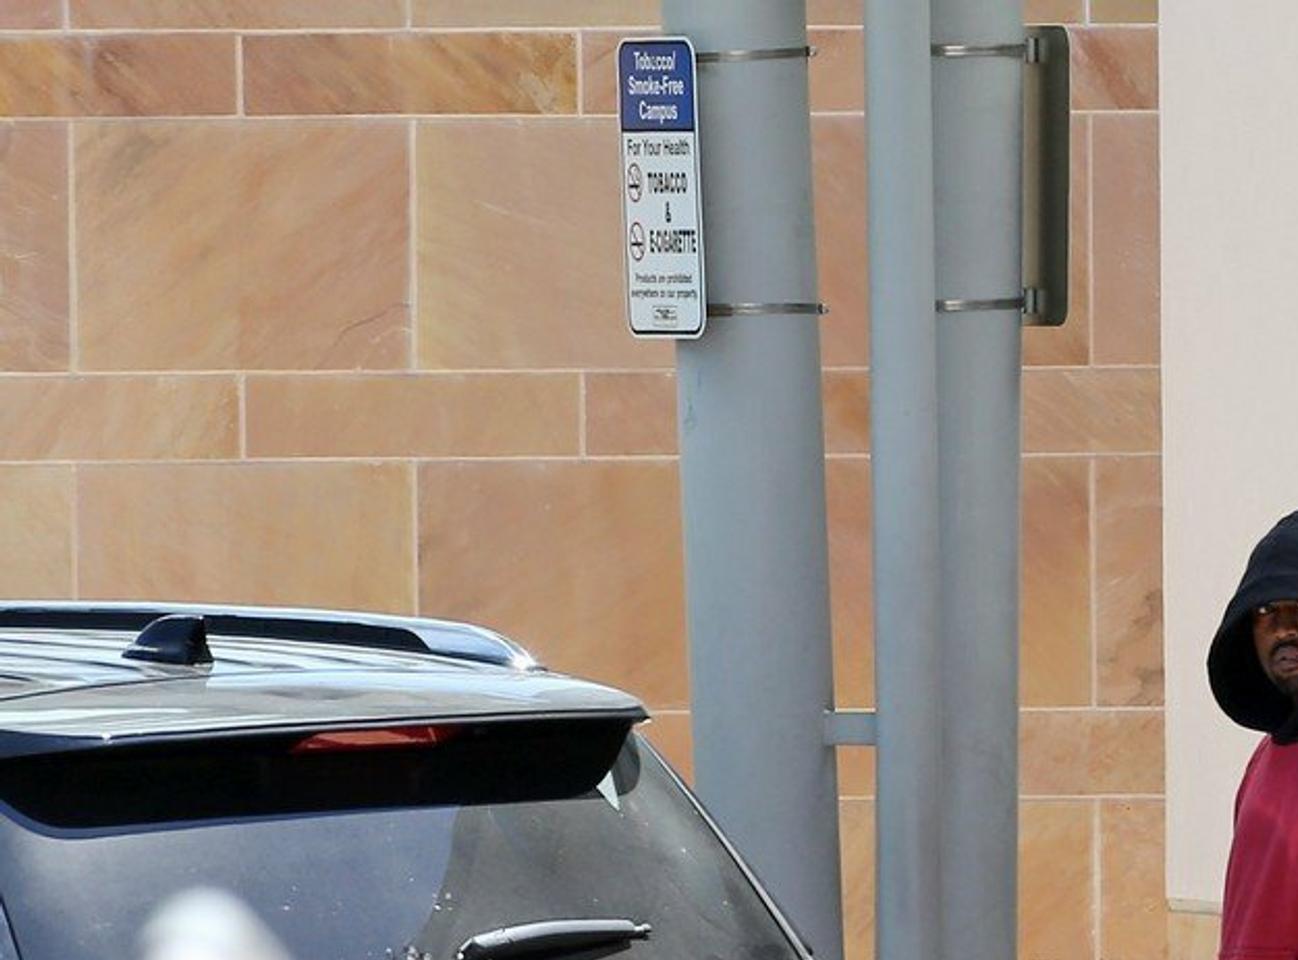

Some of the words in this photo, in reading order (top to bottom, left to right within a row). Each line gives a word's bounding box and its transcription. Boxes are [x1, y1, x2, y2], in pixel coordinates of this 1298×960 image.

[628, 75, 684, 95] Smoke-Free
[639, 100, 678, 125] Campus
[627, 139, 641, 155] For
[642, 139, 662, 156] Your
[663, 138, 690, 156] Health
[647, 172, 688, 194] TOBACCO
[665, 201, 672, 223] &
[649, 230, 697, 254] E-CIGARETTE
